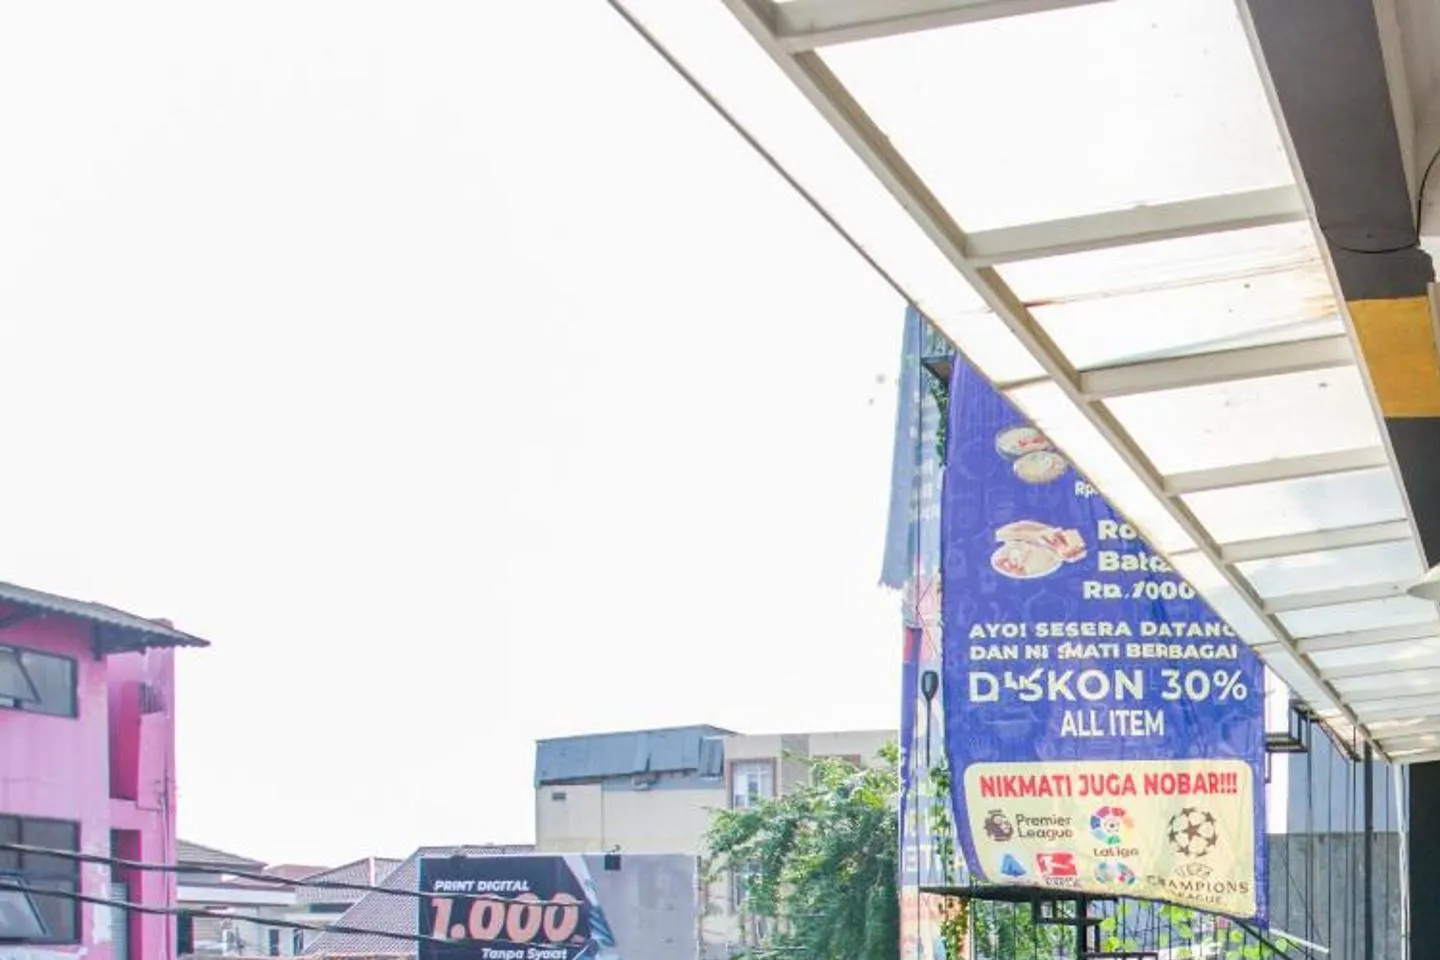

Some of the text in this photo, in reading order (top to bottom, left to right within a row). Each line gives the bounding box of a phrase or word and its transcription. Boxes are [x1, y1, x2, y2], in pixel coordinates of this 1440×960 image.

[969, 622, 1027, 638] AYO!
[970, 644, 1018, 660] DAN
[1126, 642, 1238, 659] BERBAGAI
[1161, 669, 1248, 701] 30%
[1060, 709, 1165, 737] ALL ITEM
[979, 772, 1239, 798] NIKMATI JUGA NOBAR!!!
[1015, 813, 1073, 826] Premier
[1017, 828, 1074, 841] League
[434, 879, 530, 892] PRINT DIGITAL
